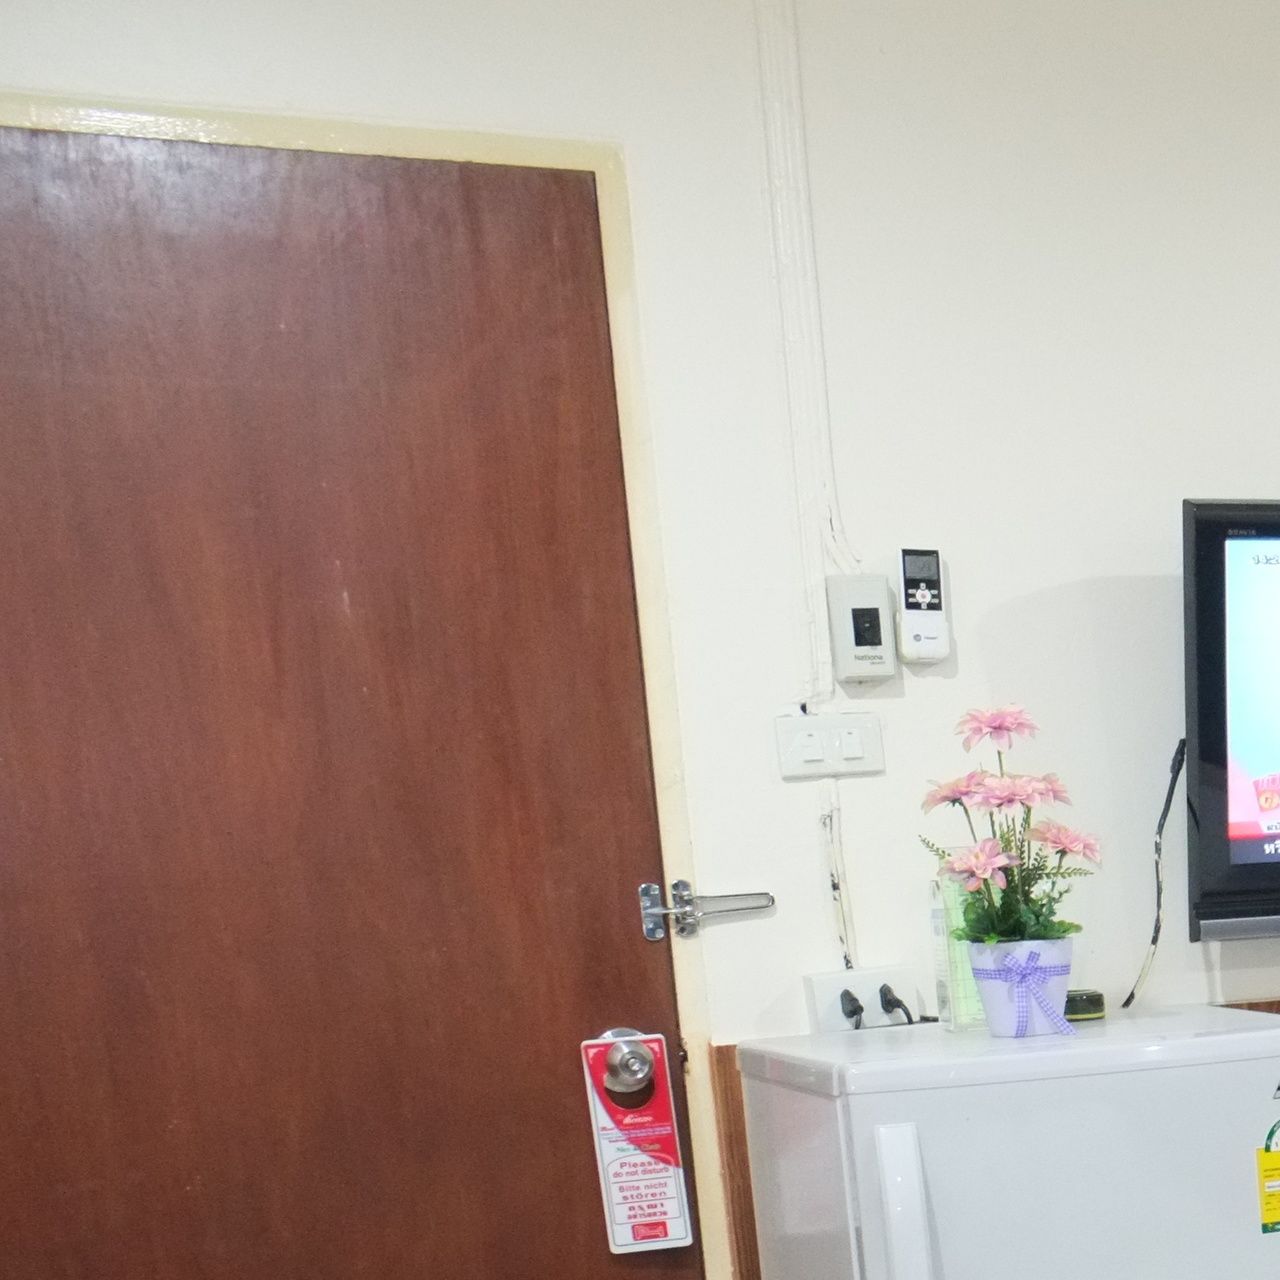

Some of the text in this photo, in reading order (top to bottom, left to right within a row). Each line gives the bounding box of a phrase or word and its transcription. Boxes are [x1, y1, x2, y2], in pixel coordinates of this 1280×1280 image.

[620, 1160, 661, 1169] Please
[612, 1170, 624, 1179] do
[640, 1166, 670, 1175] disturb
[618, 1181, 668, 1193] Bitte nicht
[622, 1191, 667, 1201] stören
